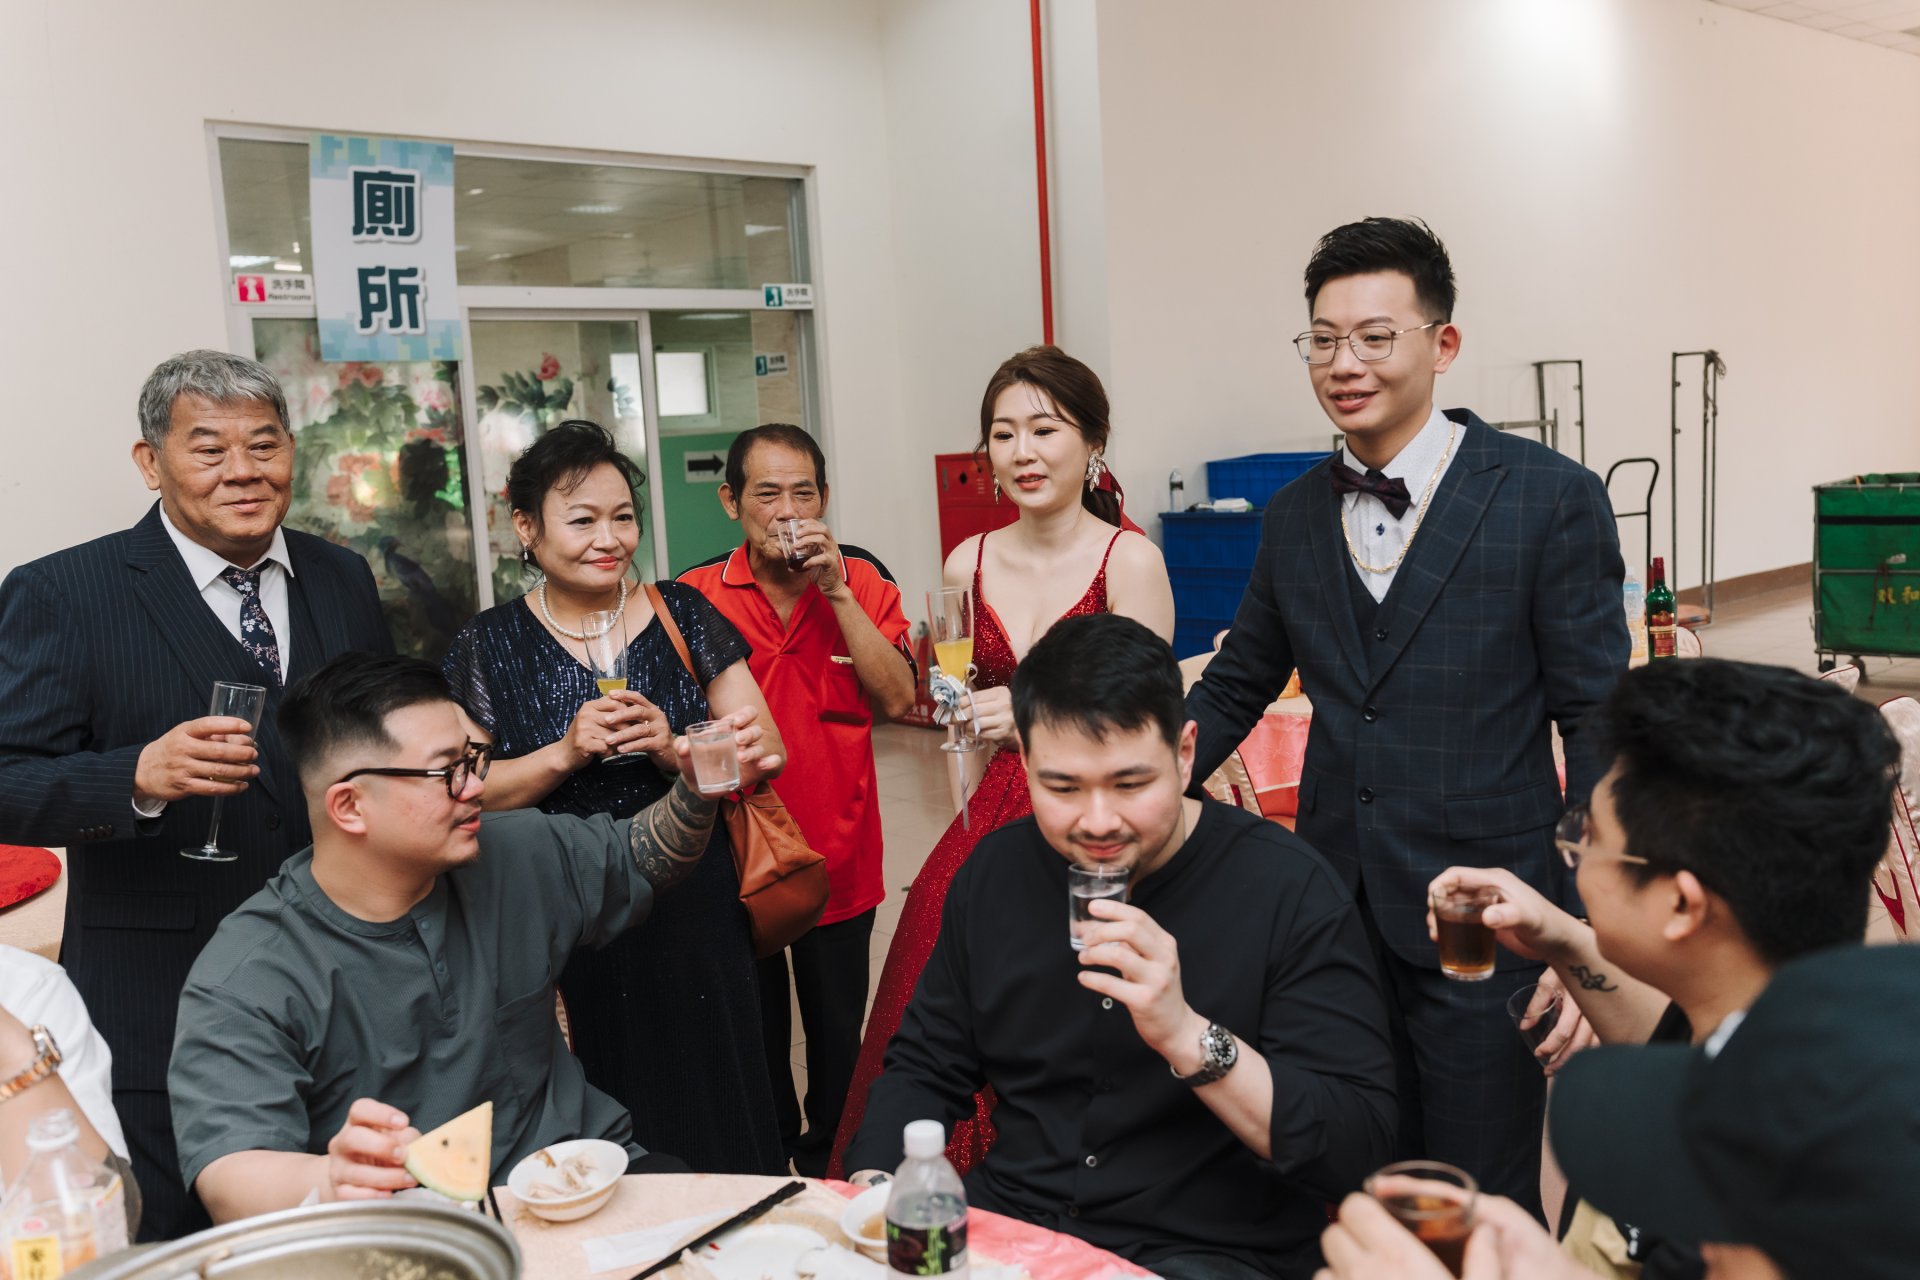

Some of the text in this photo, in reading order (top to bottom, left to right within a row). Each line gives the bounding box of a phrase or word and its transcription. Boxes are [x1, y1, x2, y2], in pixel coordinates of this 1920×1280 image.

[351, 170, 420, 330] 廁所
[272, 279, 306, 290] 洗手間
[268, 293, 312, 301] Restrooms
